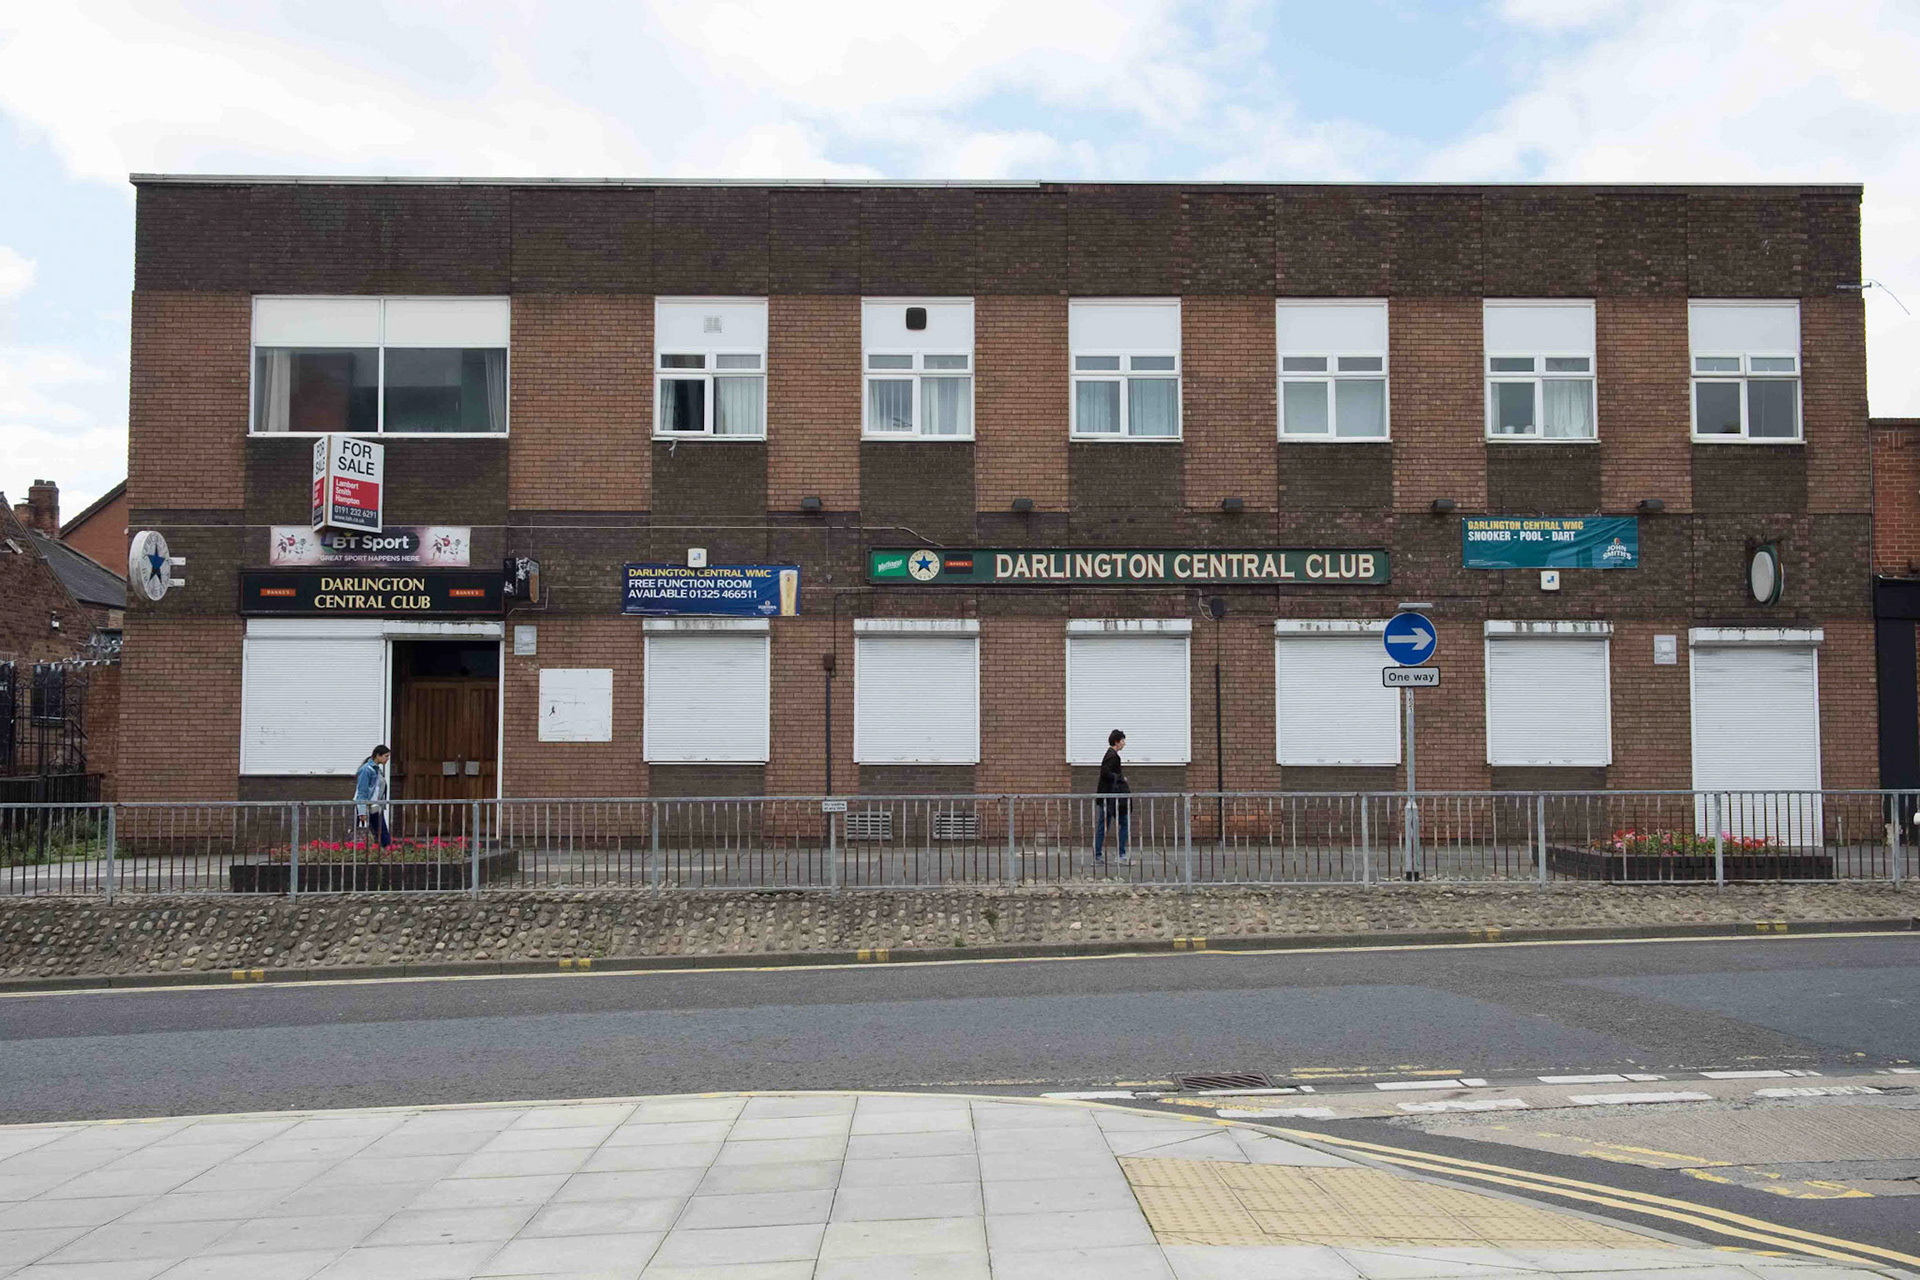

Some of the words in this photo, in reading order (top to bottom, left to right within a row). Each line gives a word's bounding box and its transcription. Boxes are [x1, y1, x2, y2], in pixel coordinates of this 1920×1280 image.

[343, 440, 372, 460] FOR
[338, 456, 375, 476] SALE
[335, 478, 359, 490] Lambert
[335, 486, 352, 496] Smith
[335, 494, 360, 505] Hampton
[334, 505, 349, 515] 0191
[350, 508, 362, 517] 232
[362, 510, 377, 519] 6291
[1467, 520, 1521, 530] DARLINGTON
[1523, 520, 1561, 530] CENTRAL
[1562, 521, 1584, 530] WMC
[1467, 531, 1511, 541] SNOOKER
[1519, 531, 1543, 541] POOL
[1552, 531, 1576, 541] DART
[332, 536, 360, 549] BT
[362, 535, 410, 551] Sport
[996, 553, 1165, 579] DARLINGTON
[1173, 553, 1295, 579] CENTRAL
[1305, 553, 1375, 579] CLUB
[628, 568, 695, 577] DARLINGTON
[697, 568, 743, 578] CENTRAL
[745, 569, 772, 578] WMC
[321, 577, 425, 592] DARLINGTON
[628, 579, 656, 588] FREE
[657, 579, 715, 588] FUNCTION
[717, 579, 752, 589] ROOM
[628, 589, 688, 599] AVAILABLE
[689, 589, 720, 599] 01325
[721, 589, 758, 599] 466511
[314, 594, 385, 609] CENTRAL
[390, 594, 431, 609] CLUB
[1388, 672, 1410, 682] One
[1413, 674, 1435, 683] way
